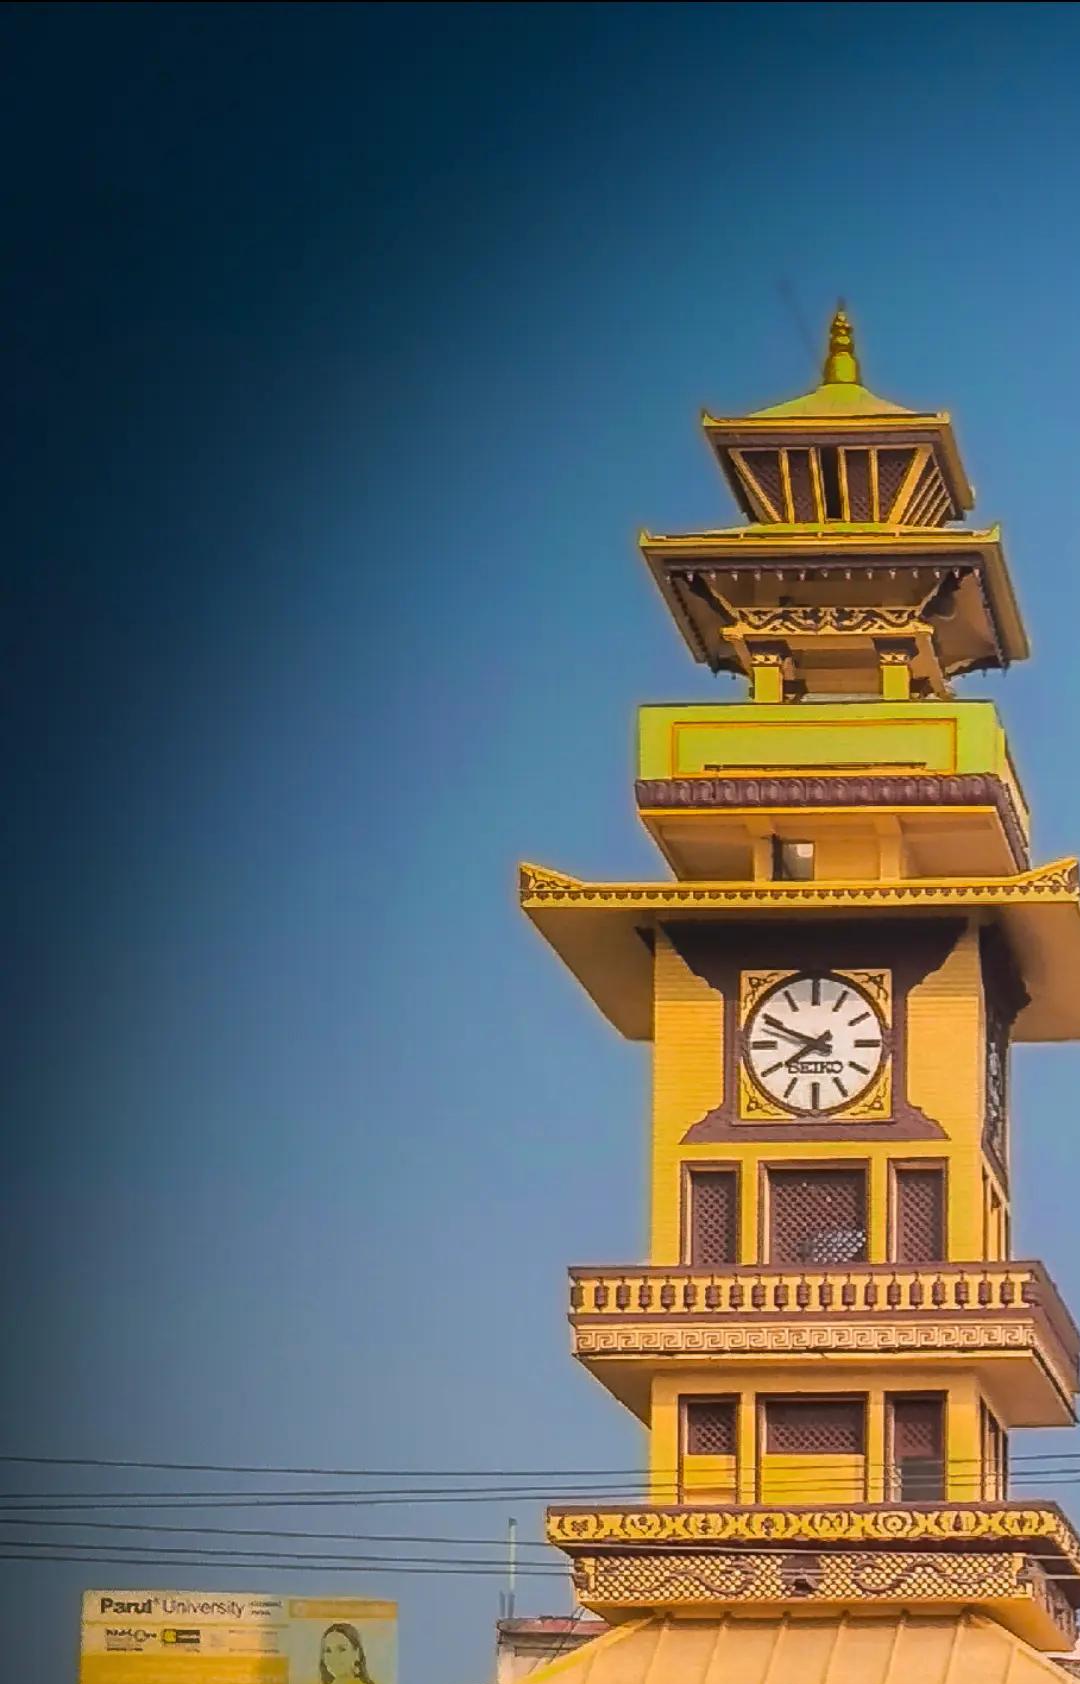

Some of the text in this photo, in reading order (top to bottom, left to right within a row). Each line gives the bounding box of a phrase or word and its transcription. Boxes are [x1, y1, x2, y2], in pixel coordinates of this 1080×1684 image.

[787, 1060, 844, 1074] SEIKO
[100, 1597, 152, 1615] Parul
[162, 1599, 245, 1618] University
